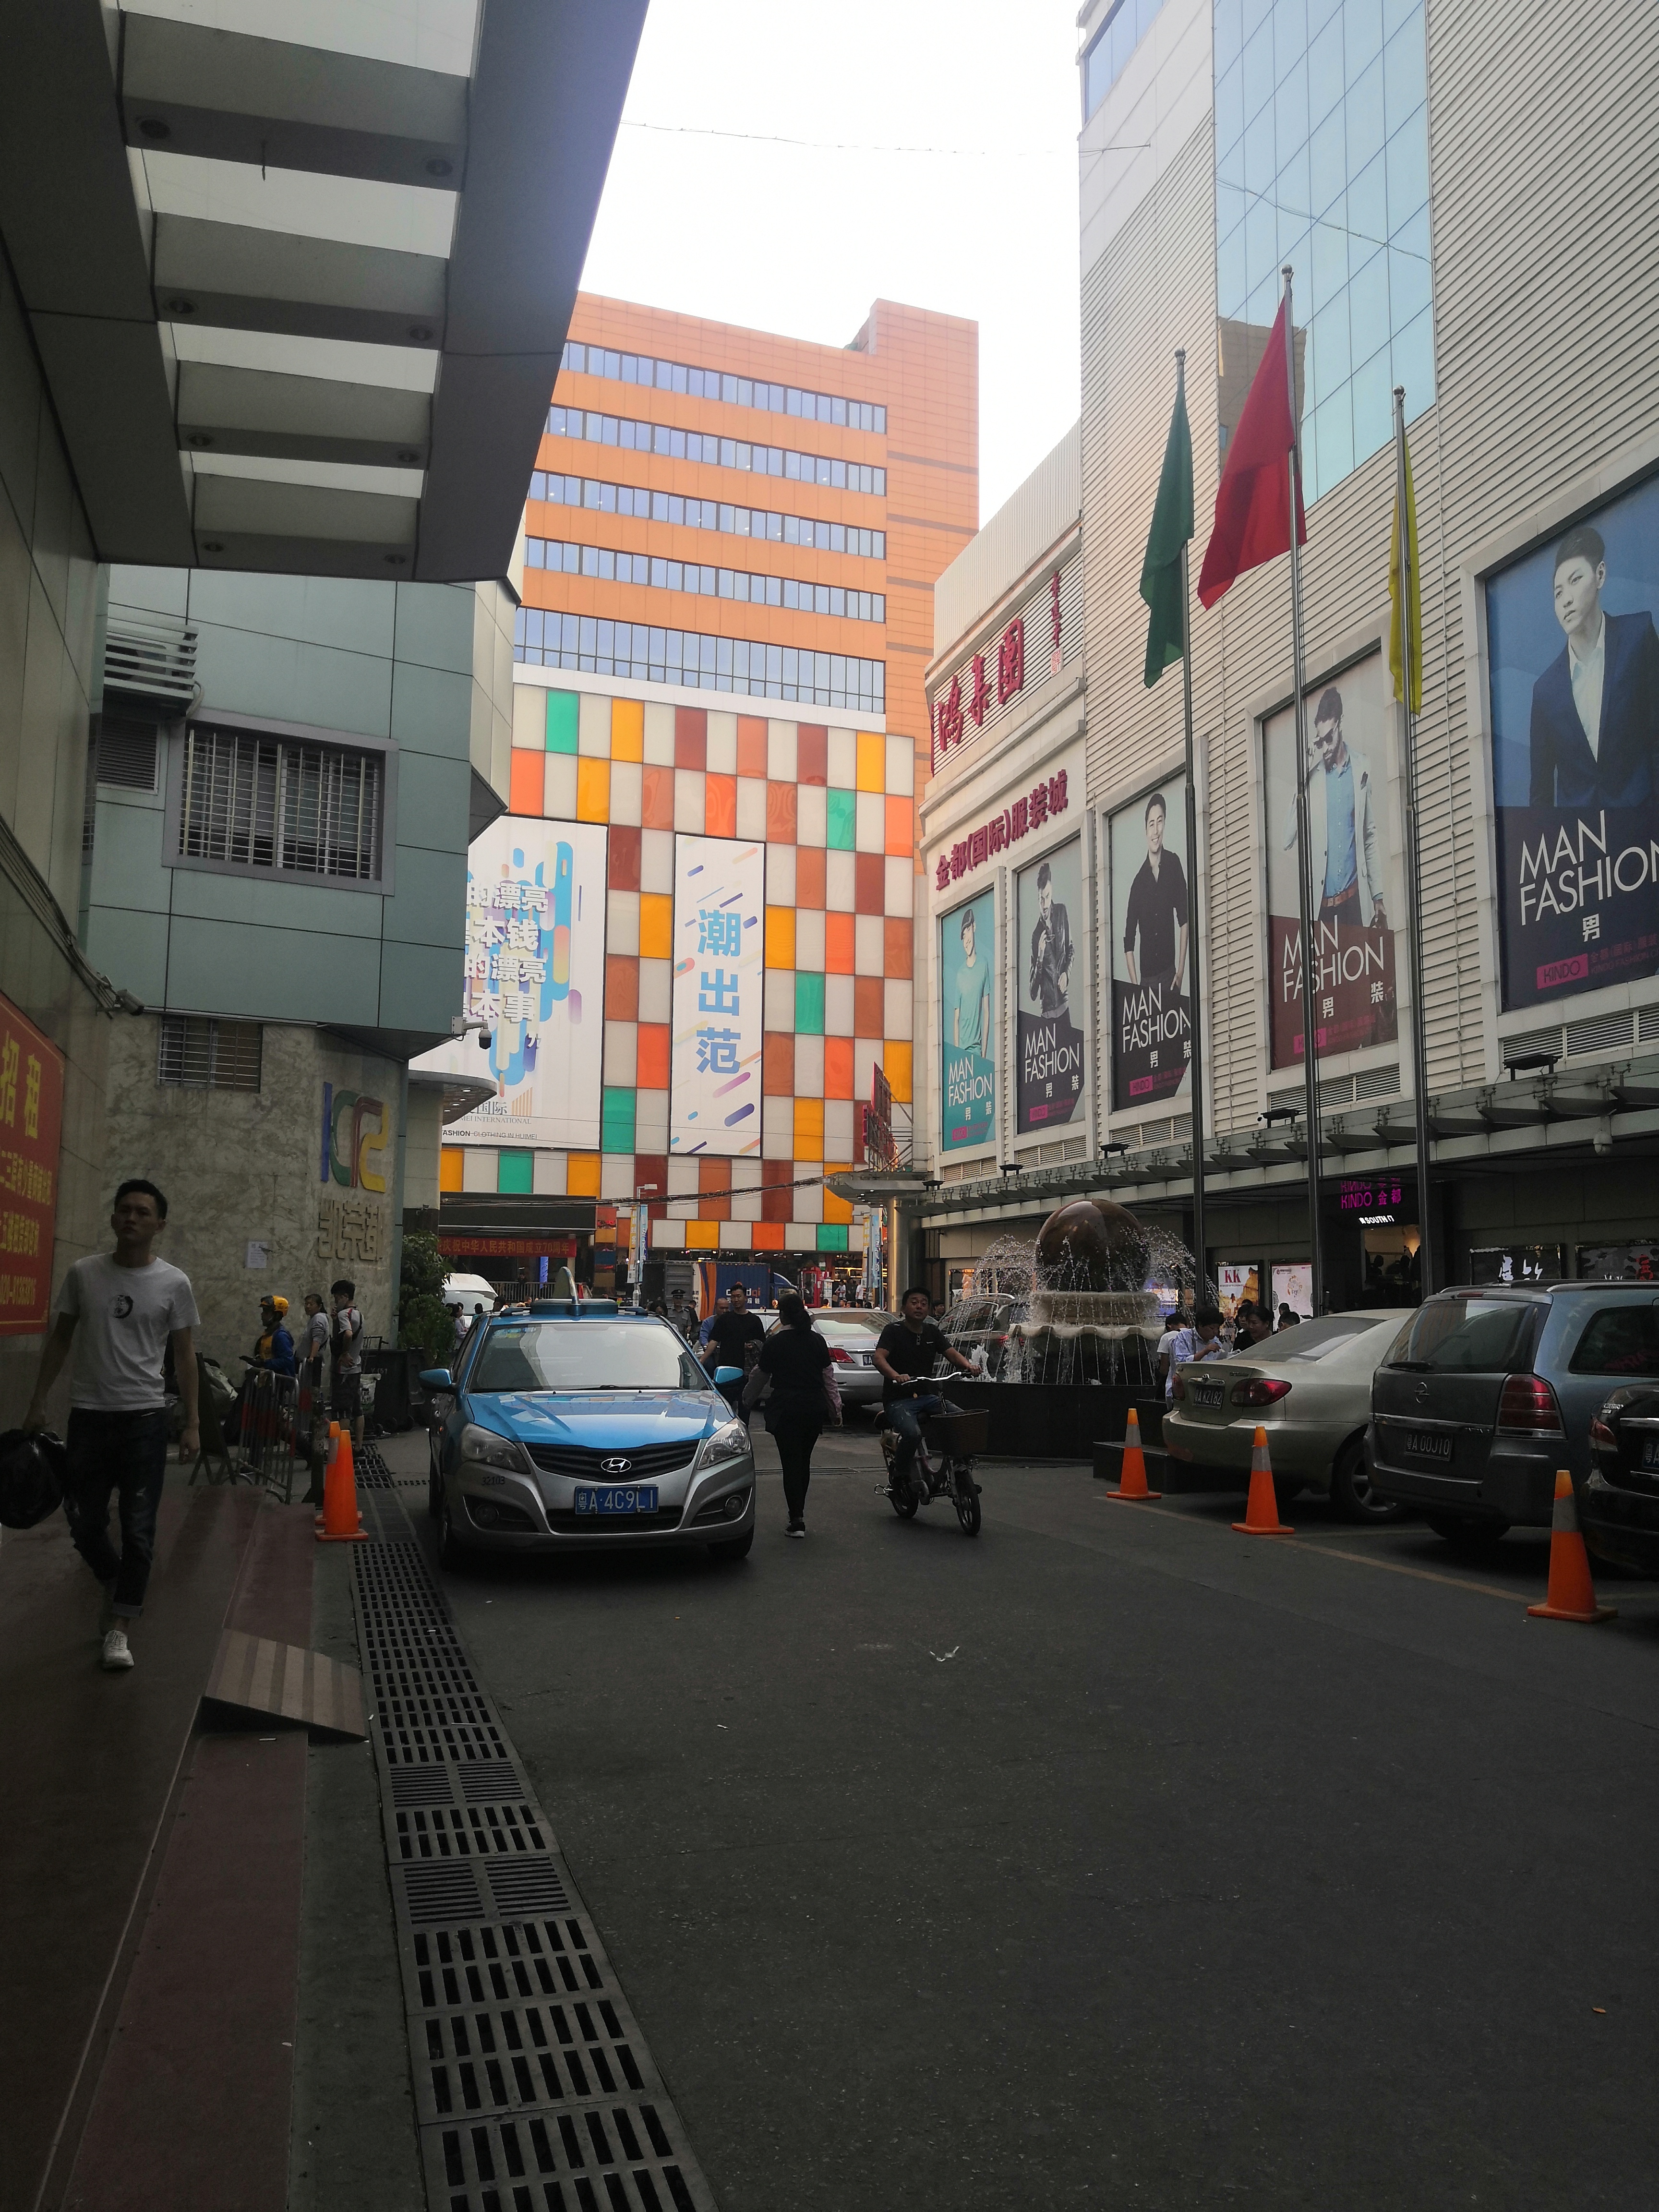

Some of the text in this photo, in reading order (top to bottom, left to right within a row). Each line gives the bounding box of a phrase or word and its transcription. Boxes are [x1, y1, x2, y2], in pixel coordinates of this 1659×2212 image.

[936, 769, 1069, 891] 金都(国际)服装城
[1519, 809, 1607, 884] MAN
[466, 882, 549, 912] 的漂亮
[1283, 914, 1338, 969] MAN
[1582, 913, 1600, 942] 男
[464, 952, 546, 984] 的漂亮
[1283, 936, 1384, 1003] FASHION
[1543, 960, 1581, 984] KINDO
[696, 909, 741, 1074] 潮出范
[1122, 983, 1162, 1025] MAN
[1322, 980, 1384, 1019] 男 装
[1025, 1023, 1056, 1059] MAN
[1122, 1007, 1191, 1053] FASHION
[948, 1054, 974, 1085] MAN
[1025, 1042, 1080, 1083] FASHION
[1150, 1050, 1159, 1069] 男
[0, 1030, 41, 1139] 招租
[948, 1072, 992, 1107] FASHION
[1046, 1082, 1053, 1098] 男
[471, 1101, 507, 1115] 国际
[474, 1116, 532, 1124] INTERNATIONAL
[965, 1106, 971, 1121] 男
[1341, 1188, 1402, 1209] KINDO 金都
[1365, 1215, 1388, 1225] SOUTH
[1224, 1269, 1241, 1284] KK
